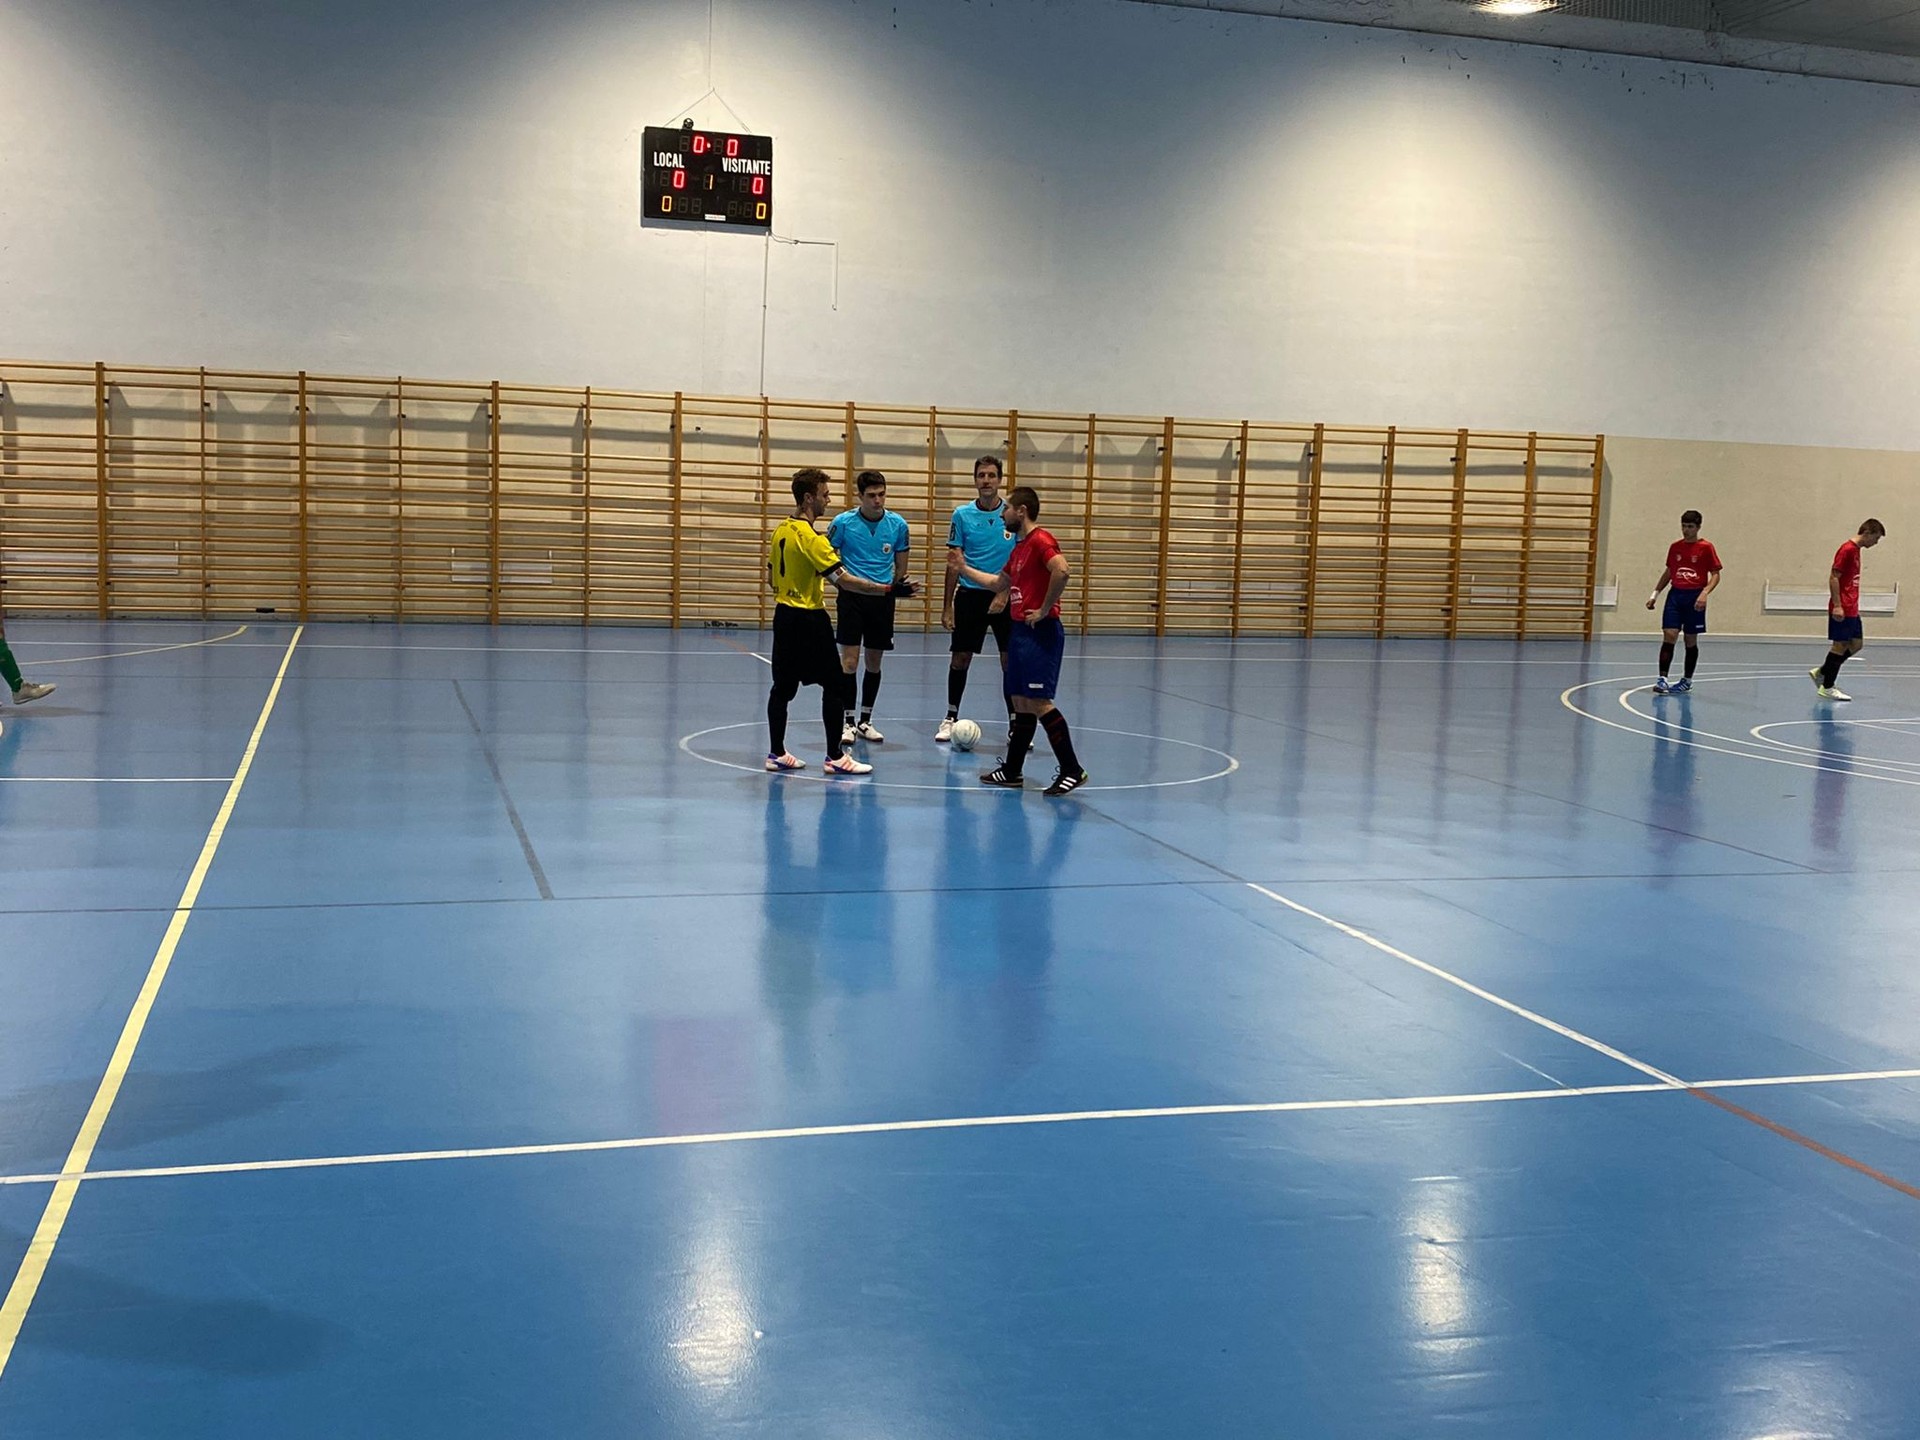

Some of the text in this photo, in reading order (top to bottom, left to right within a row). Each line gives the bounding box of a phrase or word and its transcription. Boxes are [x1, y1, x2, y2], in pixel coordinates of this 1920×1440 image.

[693, 136, 738, 156] 0 0
[653, 151, 685, 168] LOCAL
[722, 157, 771, 175] VISITANTE
[673, 170, 685, 188] 0
[752, 177, 764, 194] 0
[661, 195, 672, 212] 0
[756, 203, 767, 219] 0
[779, 537, 786, 578] 1
